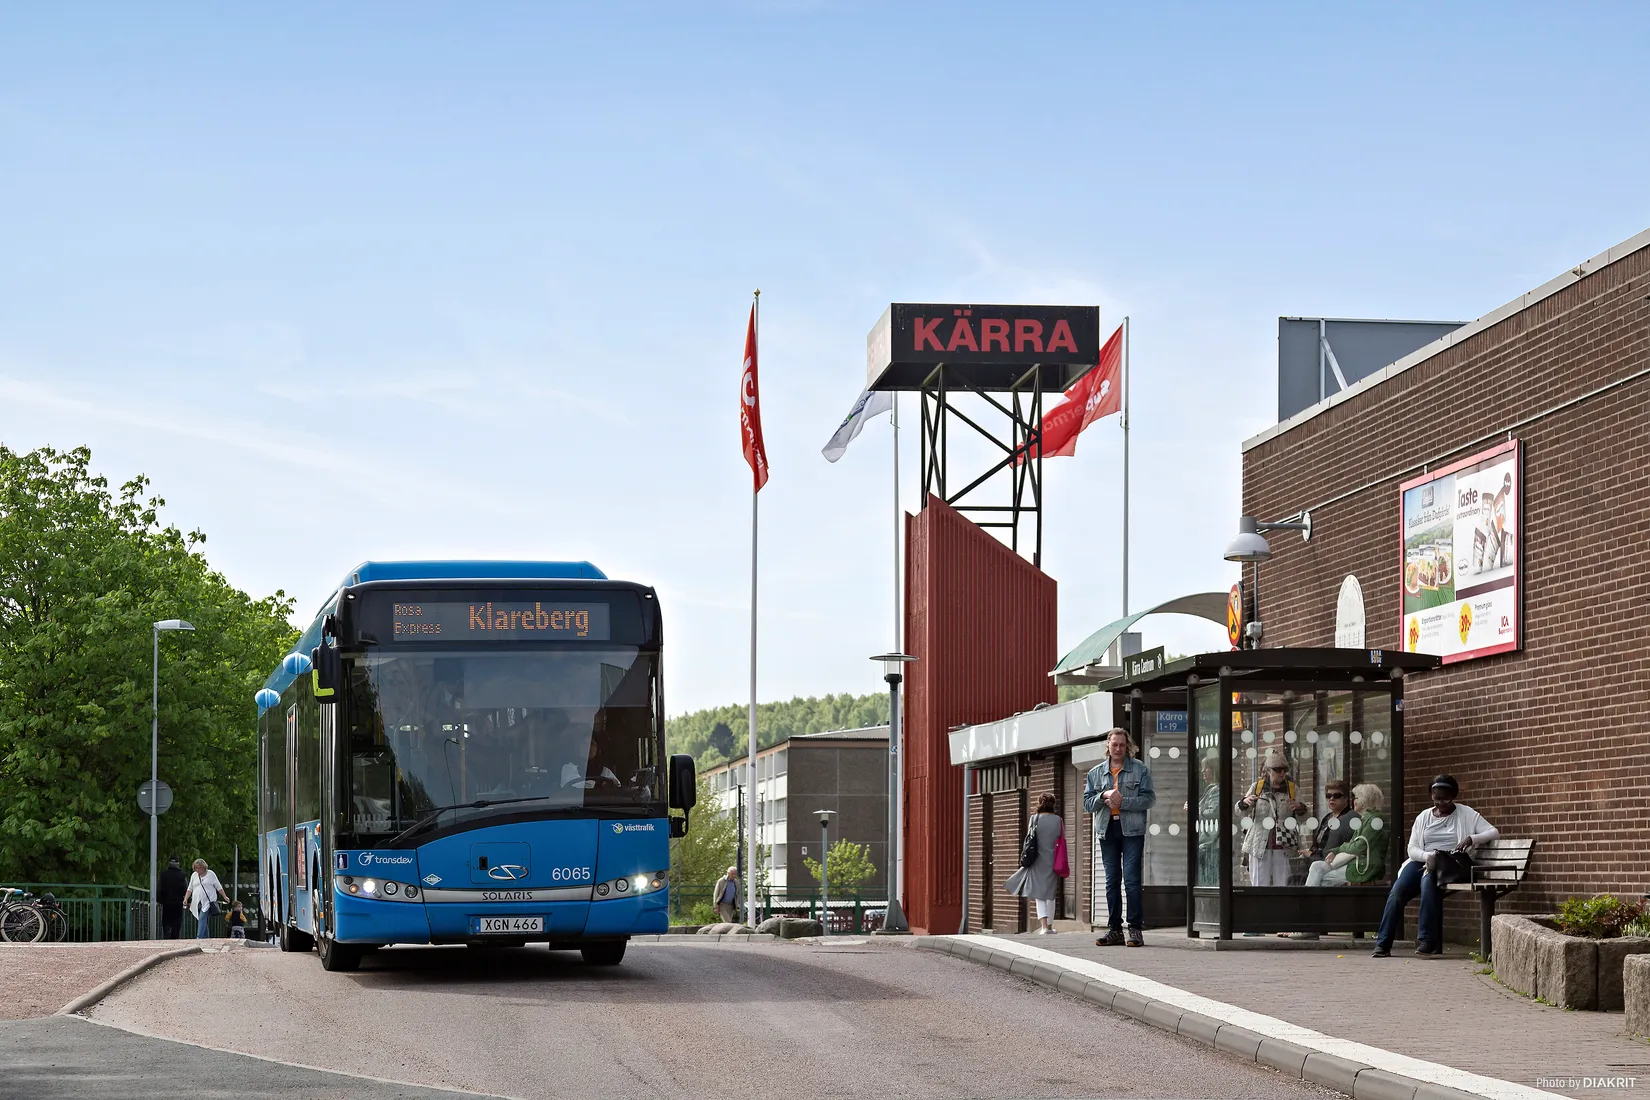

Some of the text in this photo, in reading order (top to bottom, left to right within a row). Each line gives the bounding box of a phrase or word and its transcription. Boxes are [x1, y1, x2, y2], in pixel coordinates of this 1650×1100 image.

[913, 309, 1078, 353] KÄRRA
[1457, 487, 1479, 509] Taste
[393, 603, 423, 617] Rosa
[468, 601, 590, 637] Klareberg
[1500, 615, 1510, 628] ICA
[393, 621, 442, 636] Express
[1159, 712, 1183, 721] Kärra
[624, 823, 655, 832] västtrafik
[374, 855, 413, 865] transdev
[552, 867, 591, 881] 6065
[482, 891, 533, 900] SOLARIS
[485, 918, 539, 931] XGN 466
